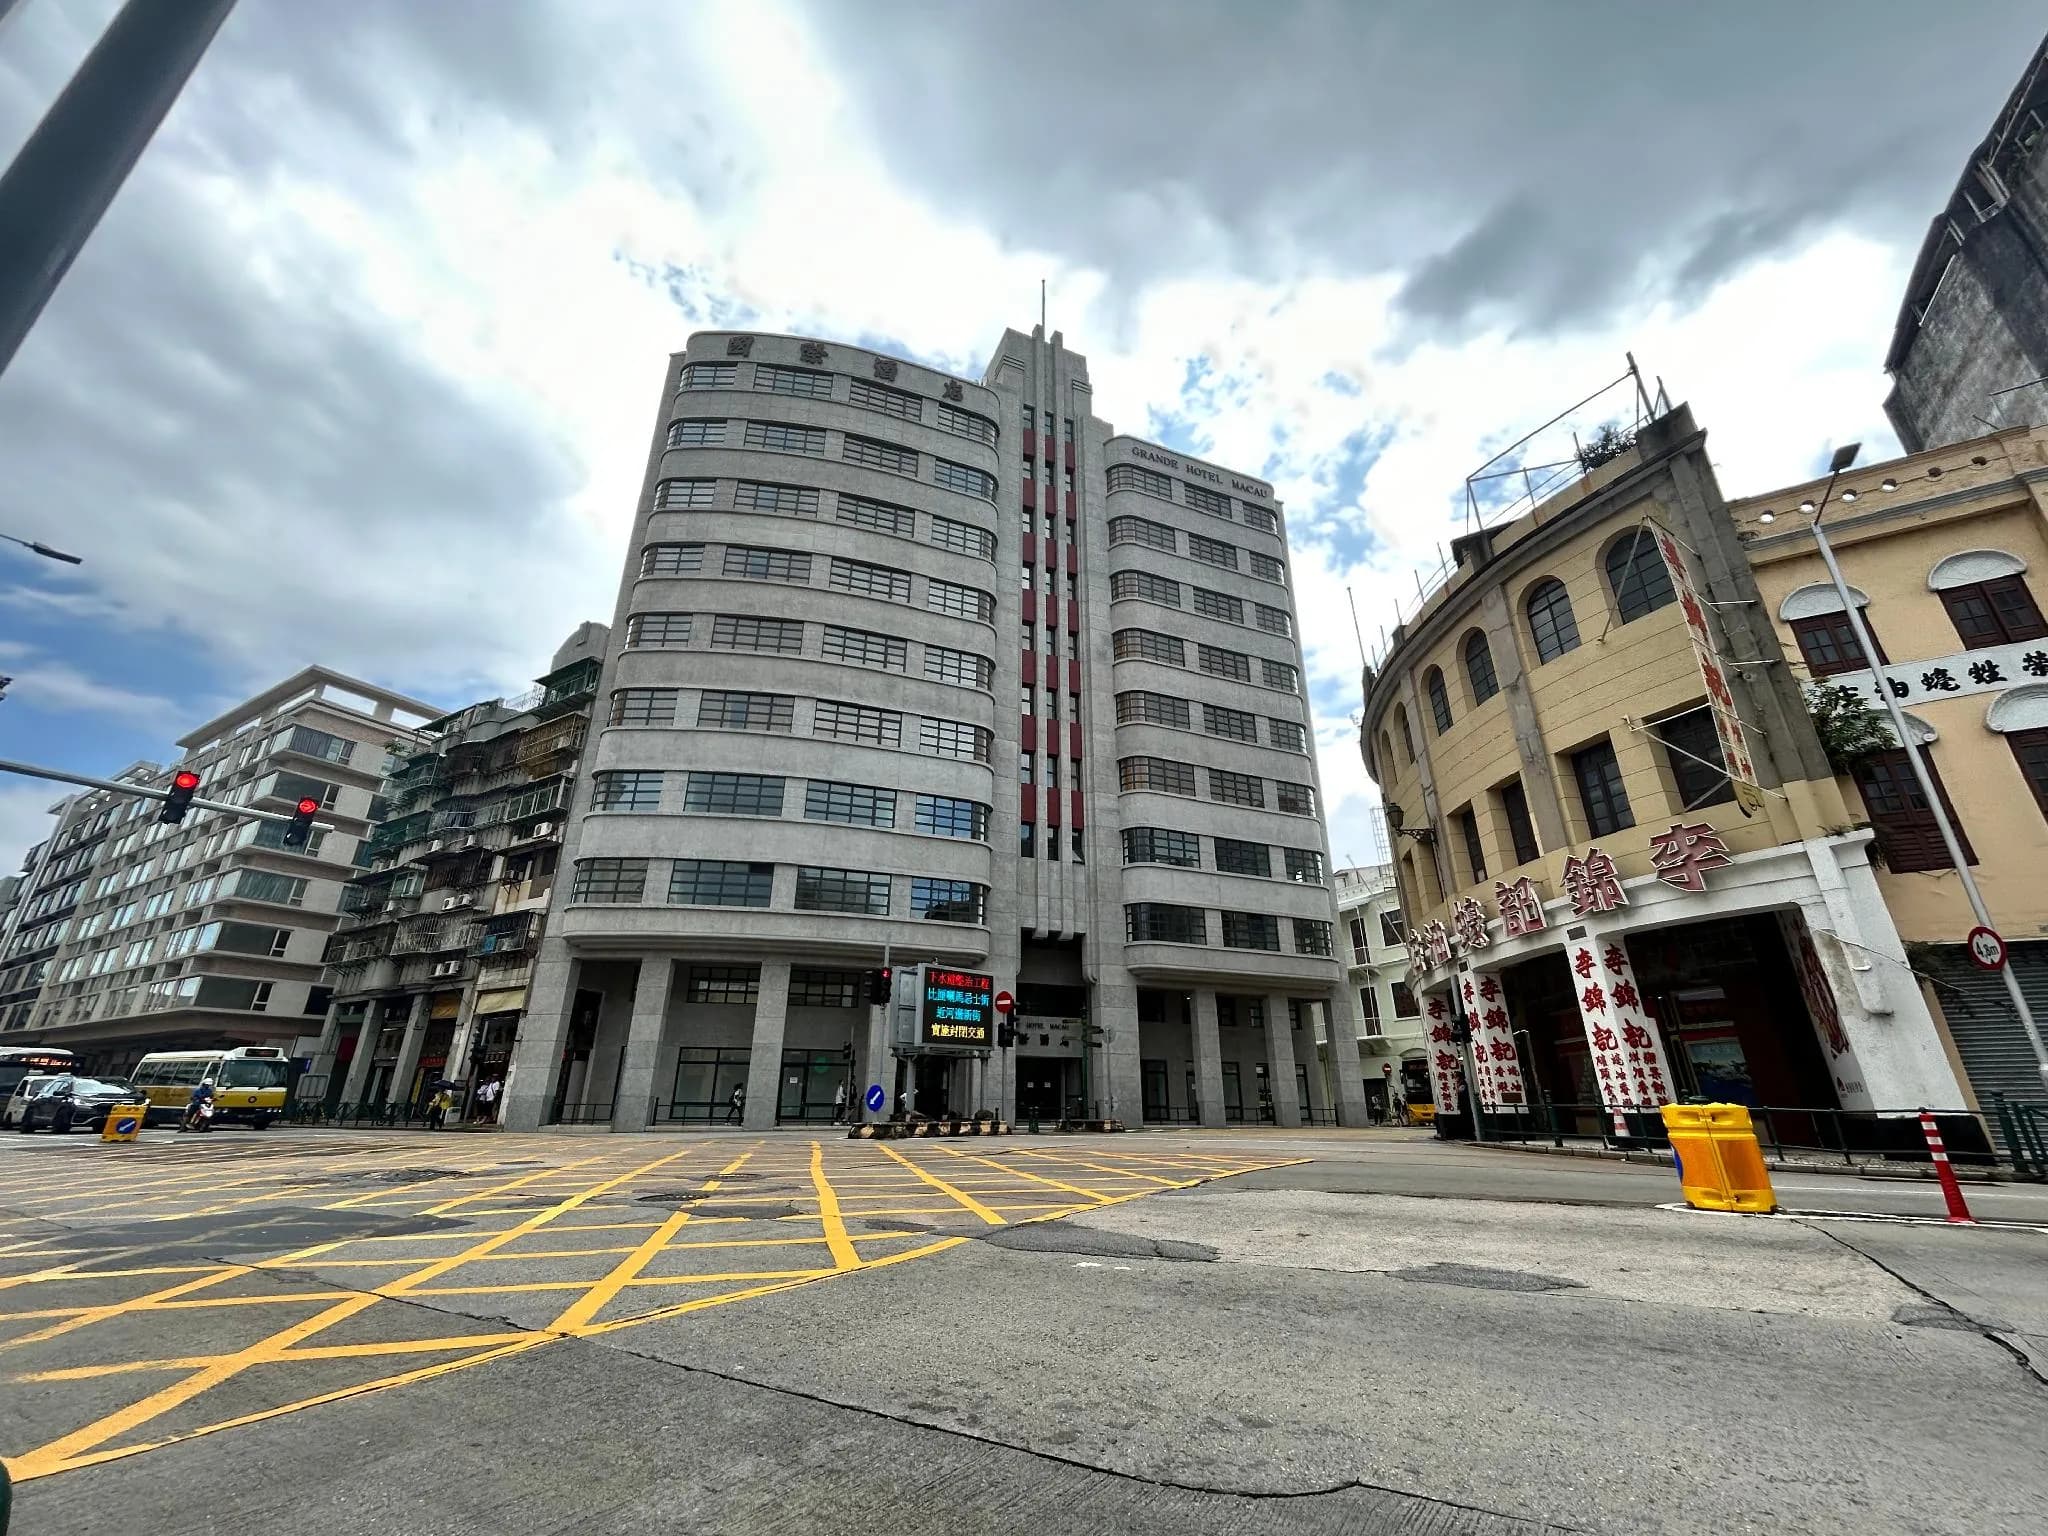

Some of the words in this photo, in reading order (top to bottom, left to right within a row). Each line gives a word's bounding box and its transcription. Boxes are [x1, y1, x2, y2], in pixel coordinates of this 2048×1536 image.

[1131, 446, 1179, 469] GRANDE
[1186, 463, 1224, 485] HOTEL
[1231, 478, 1268, 498] MACAU
[931, 1022, 985, 1039] 實施封閉交通
[1427, 997, 1460, 1071] 李錦記
[1463, 978, 1489, 1064] 李錦記
[1479, 975, 1517, 1062] 李錦記
[1574, 947, 1619, 1052] 李錦記
[1603, 943, 1654, 1050] 李錦記
